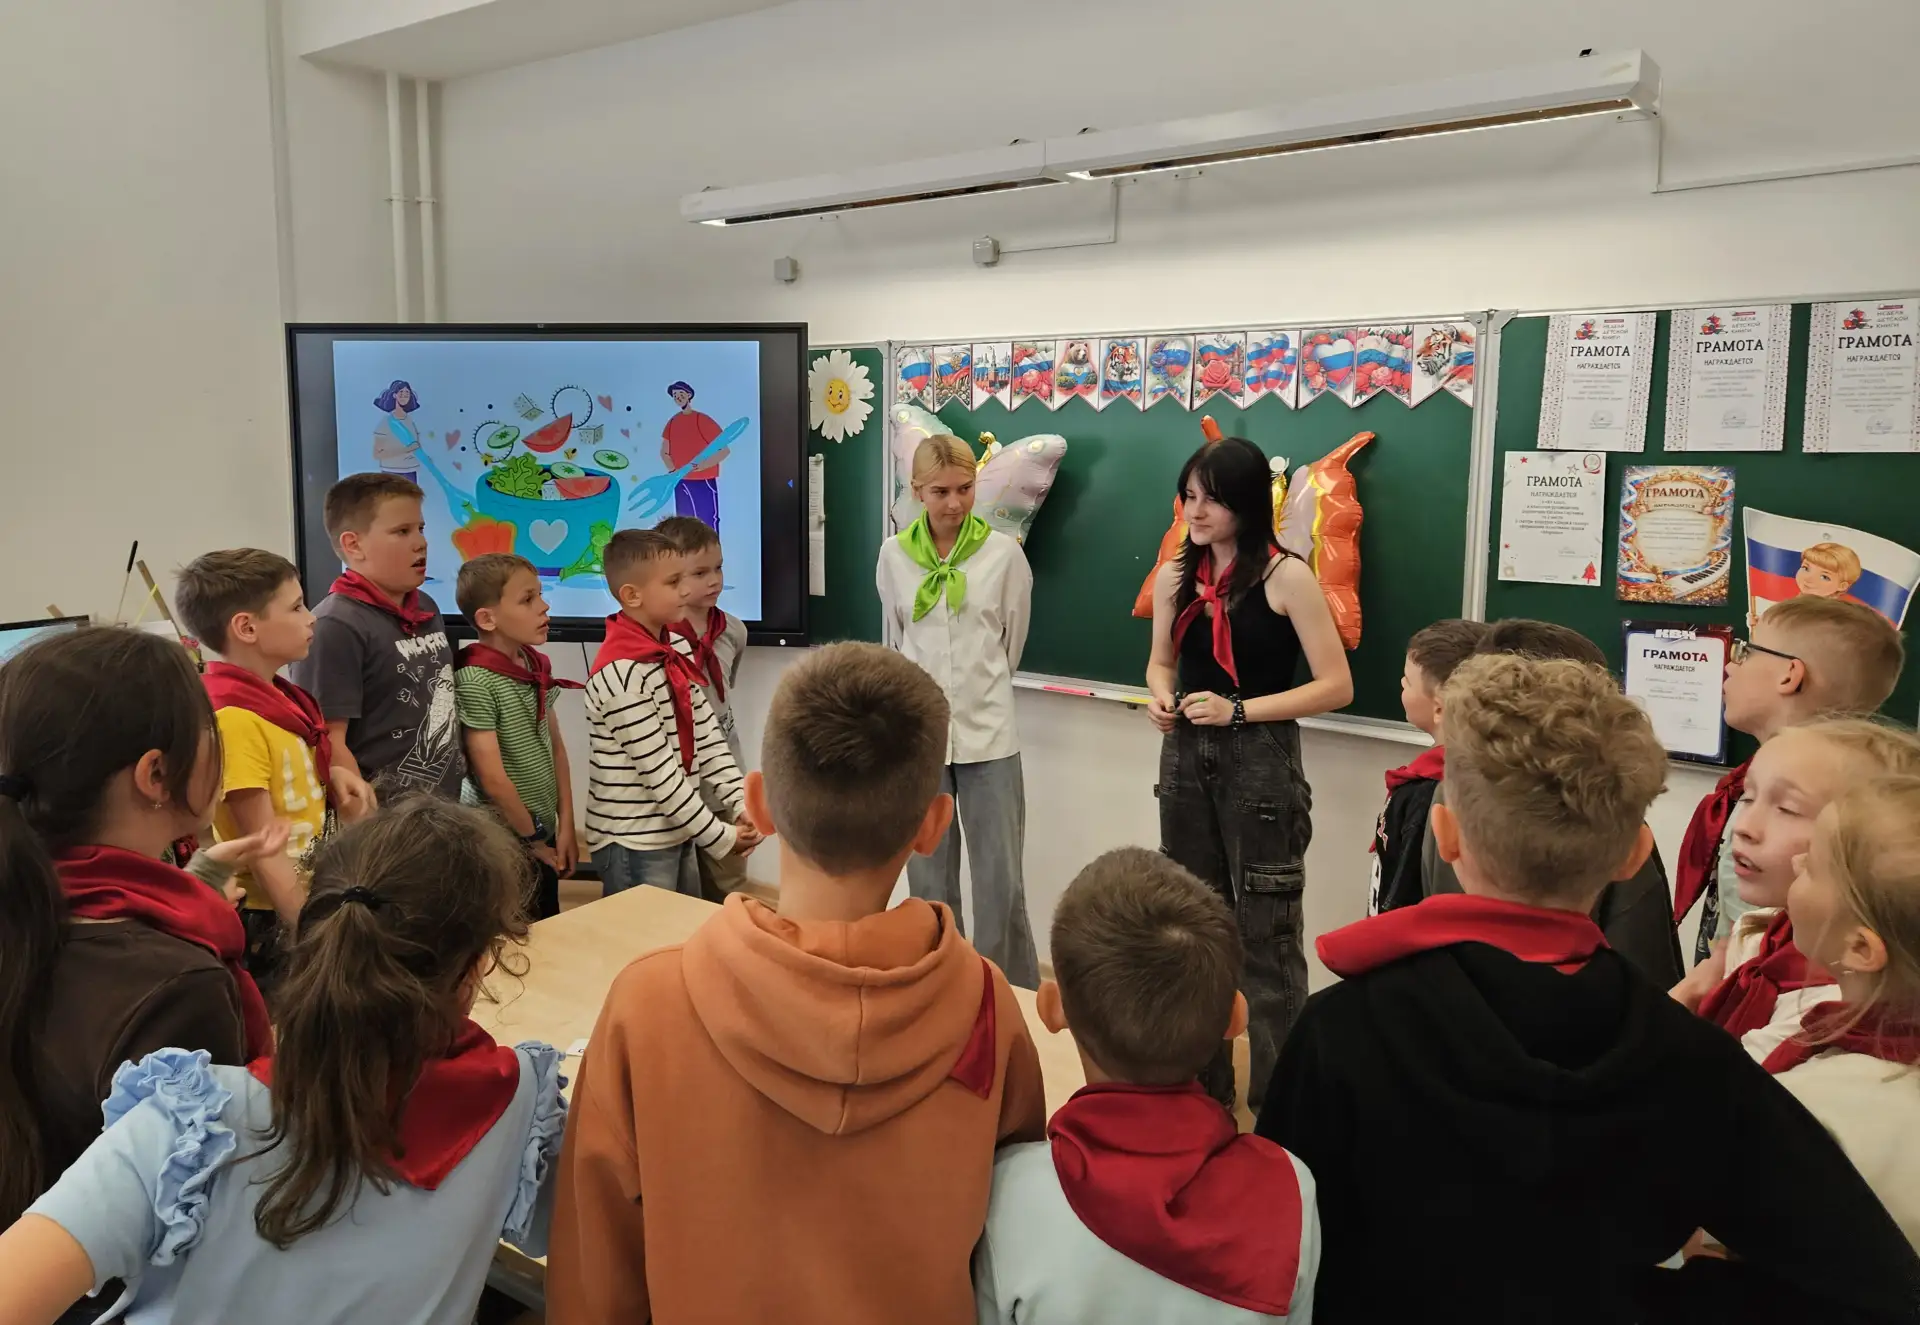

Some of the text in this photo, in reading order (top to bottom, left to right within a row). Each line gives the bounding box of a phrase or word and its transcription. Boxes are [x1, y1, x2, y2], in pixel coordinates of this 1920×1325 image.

[1696, 339, 1764, 353] ГРАМОТА
[1838, 334, 1913, 349] ГРАМОТА
[1570, 345, 1631, 357] ГРАМОТА
[1704, 358, 1754, 366] НАГРАЖДАЕТСЯ
[1846, 353, 1902, 362] НАГРАЖДАЕТСЯ
[1576, 362, 1621, 370] НАГРАЖДАЕТСЯ
[1526, 475, 1583, 488] ГРАМОТА
[1644, 487, 1705, 499] ГРАМОТА
[1654, 629, 1697, 640] КВН
[1642, 648, 1709, 663] ГРАМОТА
[1654, 663, 1696, 673] НАГРАЖДАЕТСЯ
